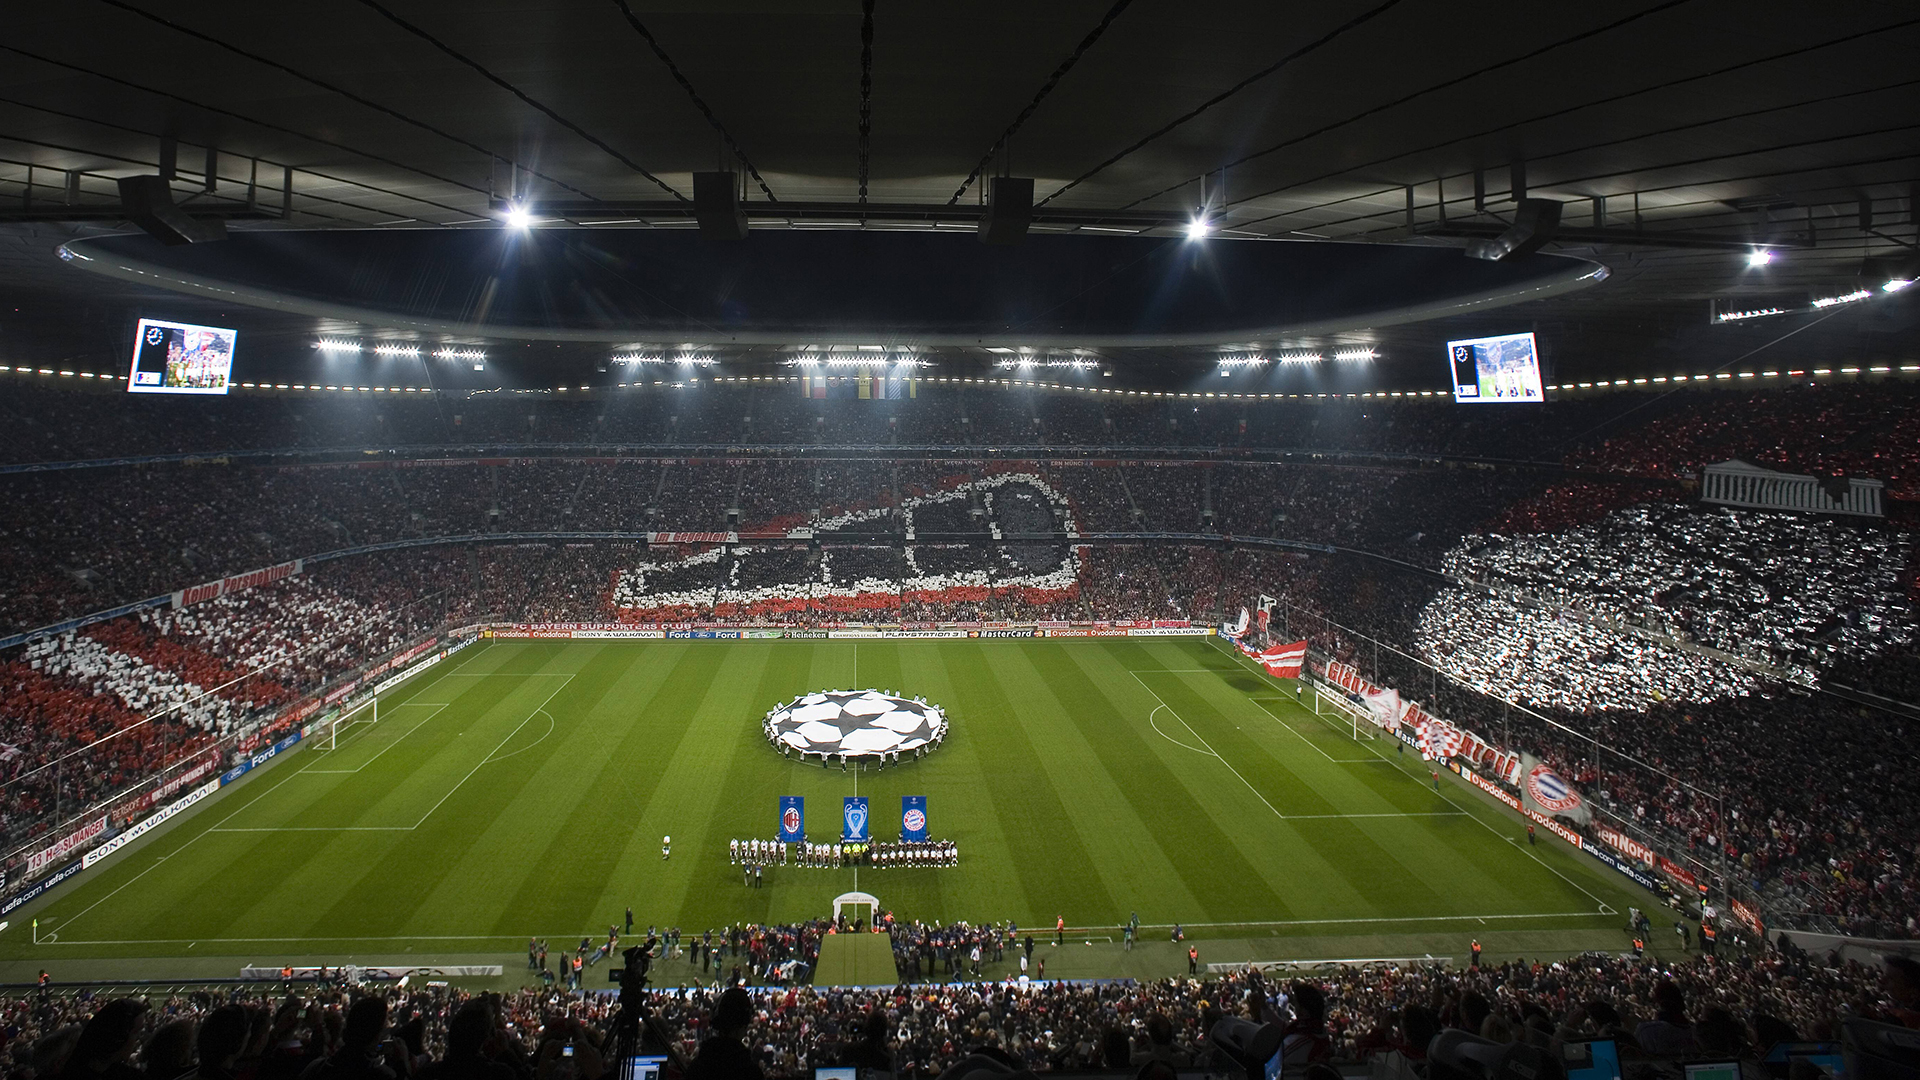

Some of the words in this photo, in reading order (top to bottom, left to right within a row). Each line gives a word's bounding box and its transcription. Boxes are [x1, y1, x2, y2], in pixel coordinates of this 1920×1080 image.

[181, 582, 219, 606] Keine
[222, 560, 297, 594] Perspektive?
[447, 634, 477, 656] MasterCard
[791, 631, 827, 639] Heineken
[251, 746, 276, 768] Ford
[1480, 782, 1519, 810] vodafone
[1531, 810, 1577, 846] vodafone
[31, 854, 42, 869] 13
[88, 834, 128, 864] SONY
